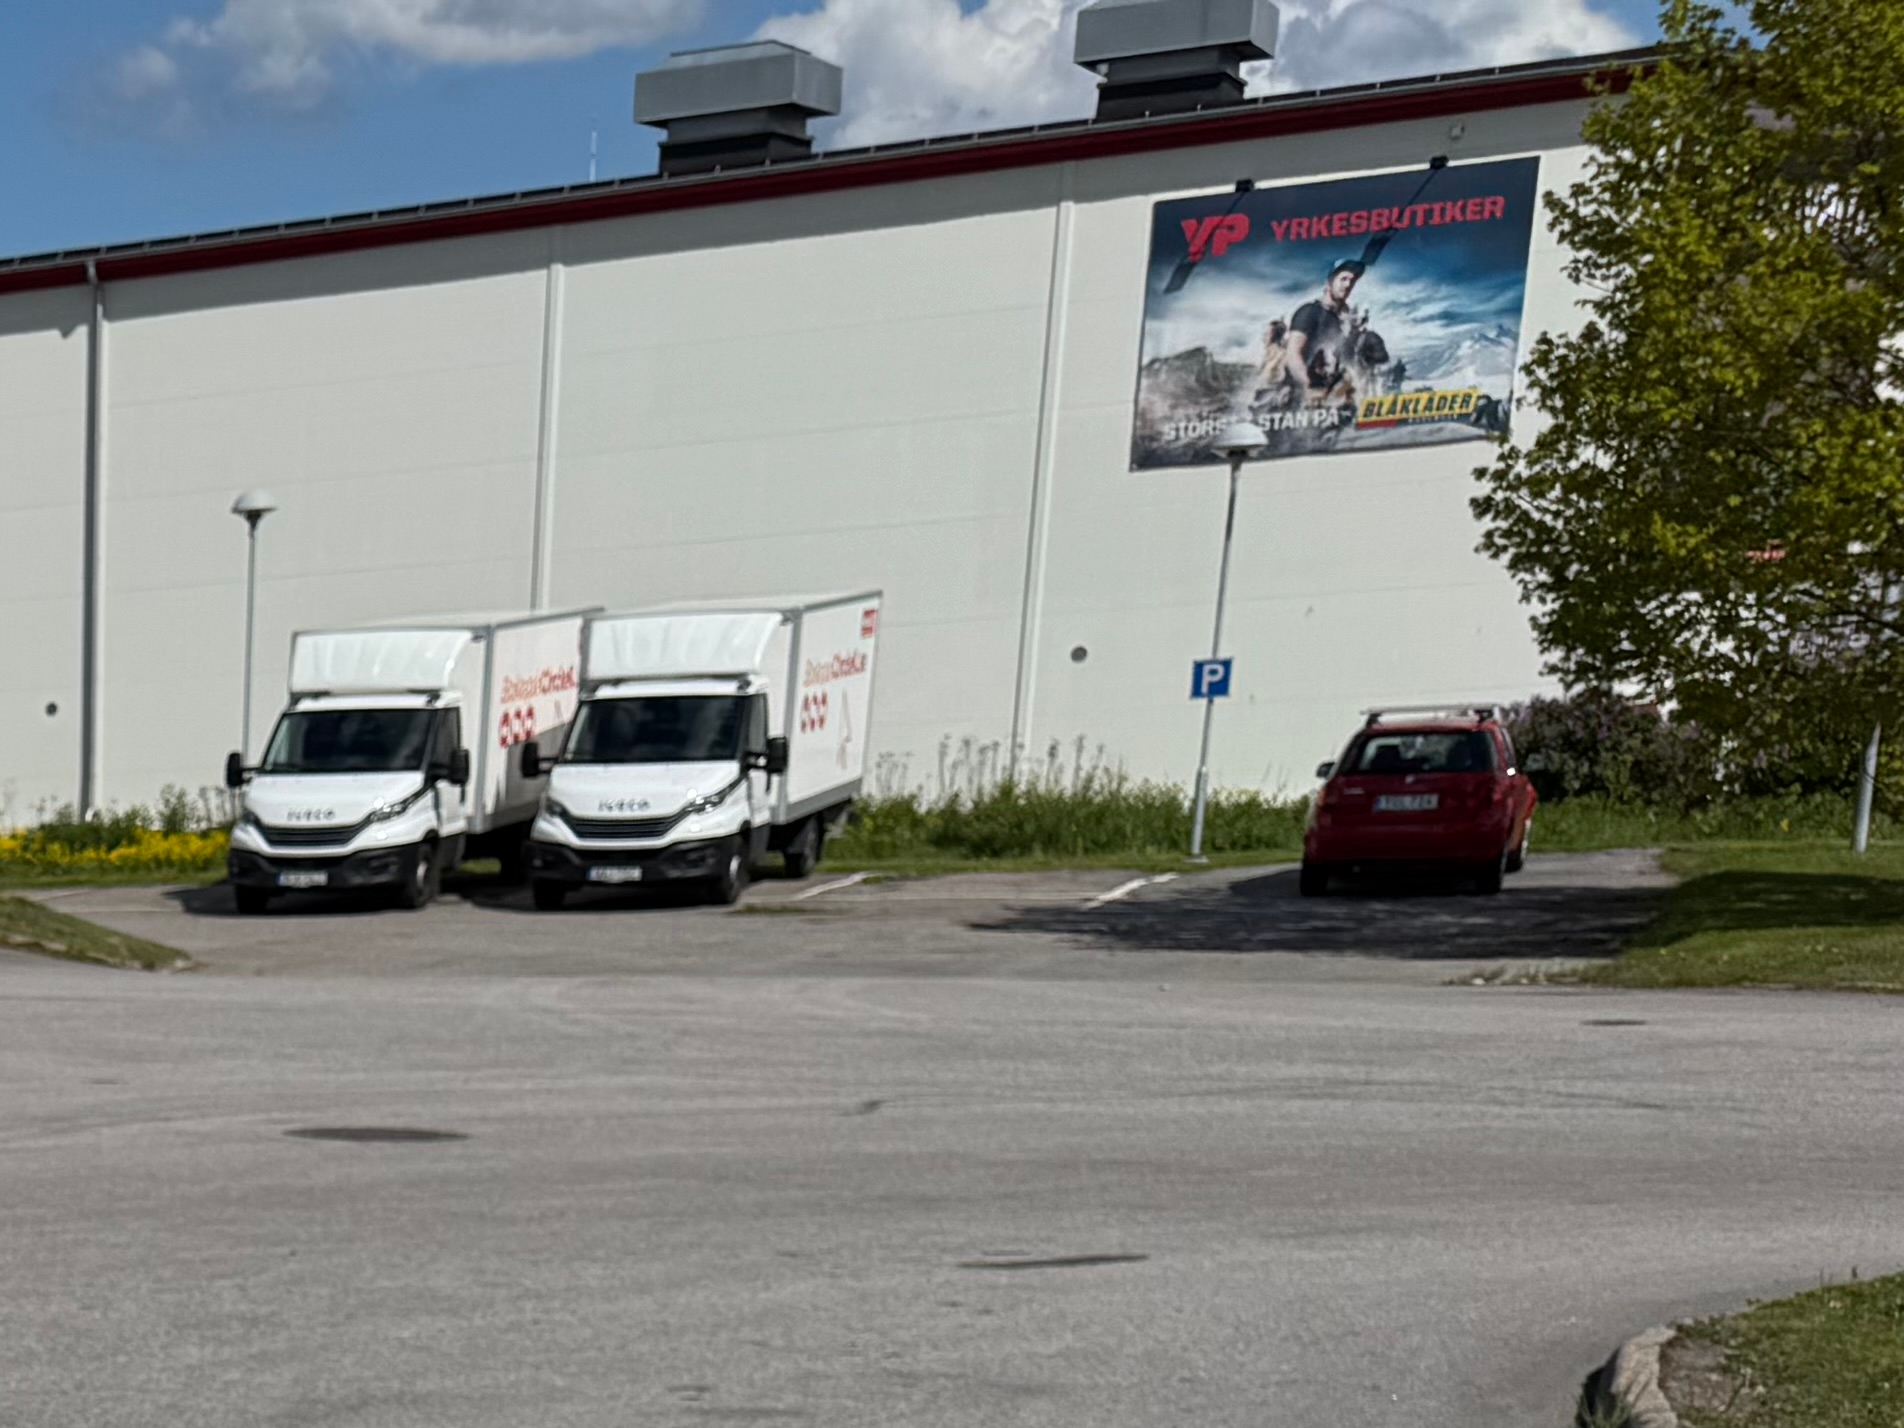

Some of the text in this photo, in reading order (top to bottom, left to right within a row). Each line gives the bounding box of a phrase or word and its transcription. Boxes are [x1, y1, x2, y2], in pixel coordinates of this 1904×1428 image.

[1181, 196, 1505, 262] YP YRKESBUTIKER
[1258, 411, 1308, 431] STAN
[1201, 663, 1225, 694] P
